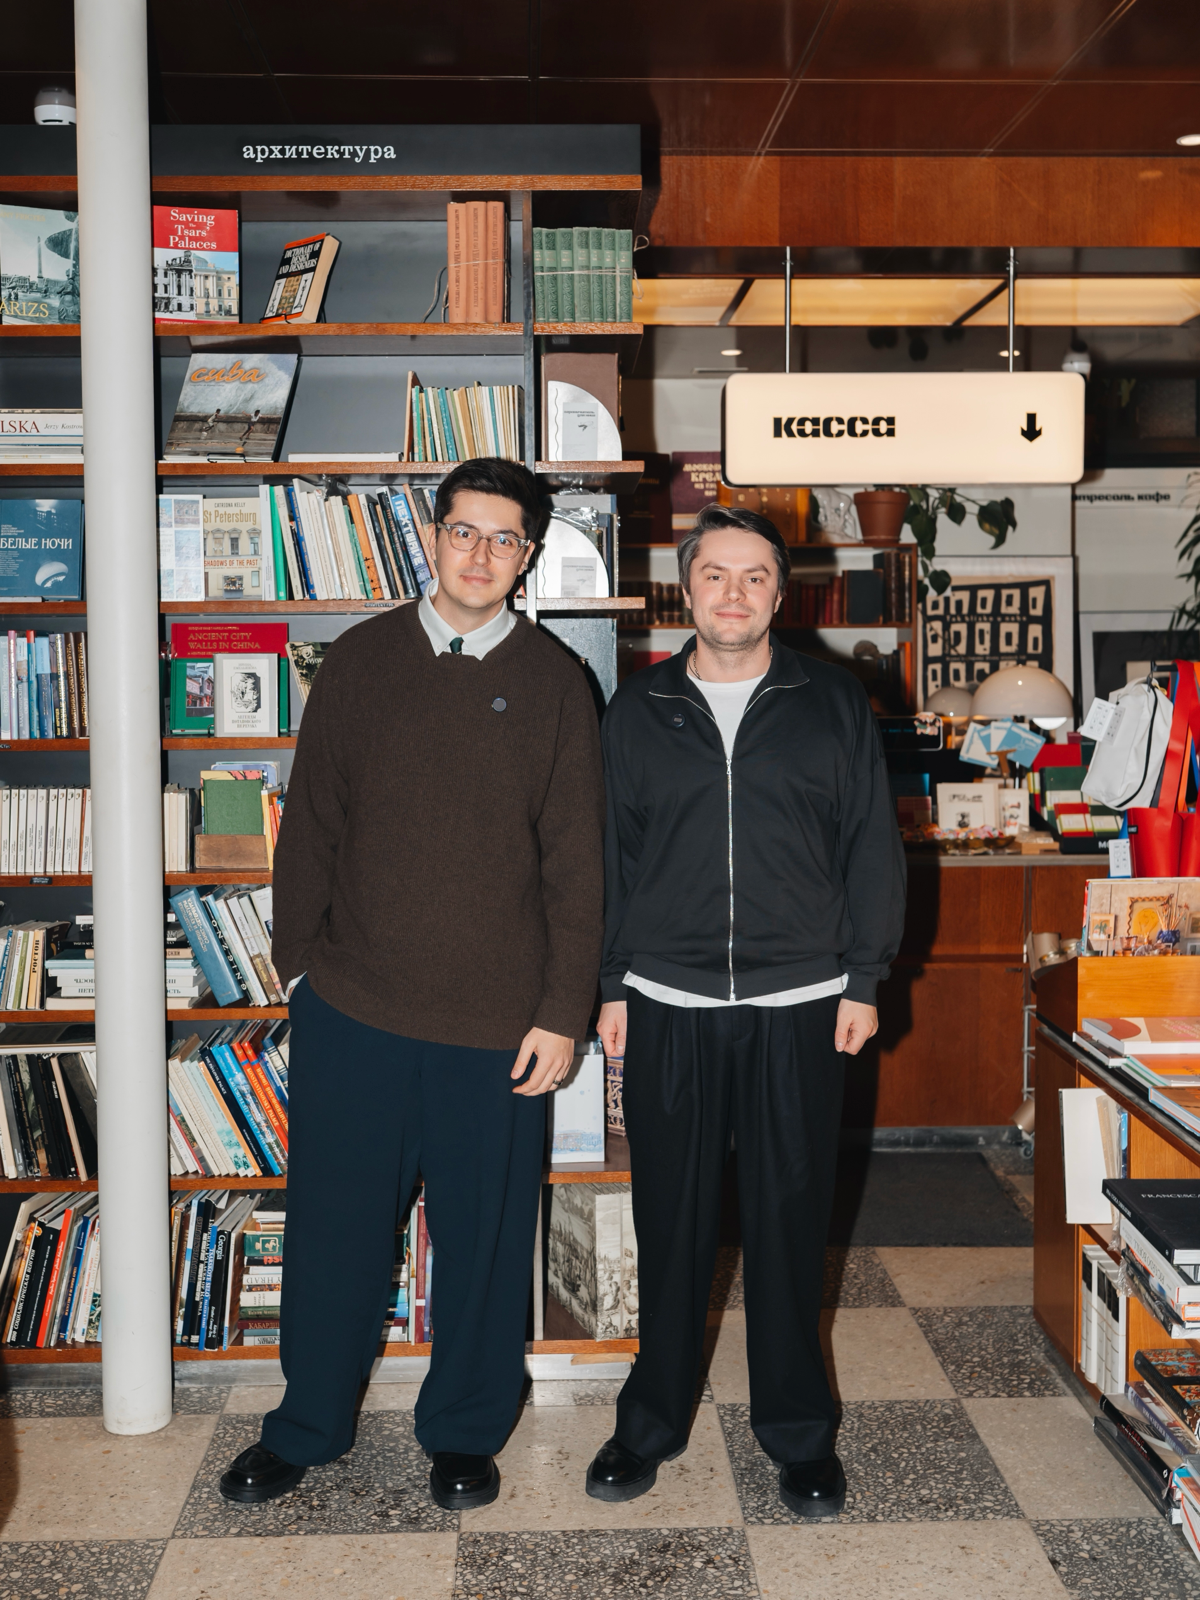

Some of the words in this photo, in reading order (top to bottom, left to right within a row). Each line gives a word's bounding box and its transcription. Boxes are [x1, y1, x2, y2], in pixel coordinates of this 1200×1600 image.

[242, 144, 397, 163] архитектура
[170, 209, 215, 226] Saving
[169, 235, 217, 249] Palaces
[313, 241, 322, 251] OF
[0, 299, 49, 318] ÁRIZS
[190, 360, 267, 383] cuba
[0, 420, 40, 433] LSKA
[773, 416, 896, 438] касса
[1137, 490, 1171, 504] кафе
[203, 510, 212, 523] St
[214, 509, 257, 525] Petersburg
[0, 538, 38, 549] БЕЛЫЕ
[41, 538, 73, 550] НОЧИ
[32, 940, 40, 973] РОСТОВ
[267, 1109, 279, 1127] PALACE
[216, 1234, 227, 1260] Georgia
